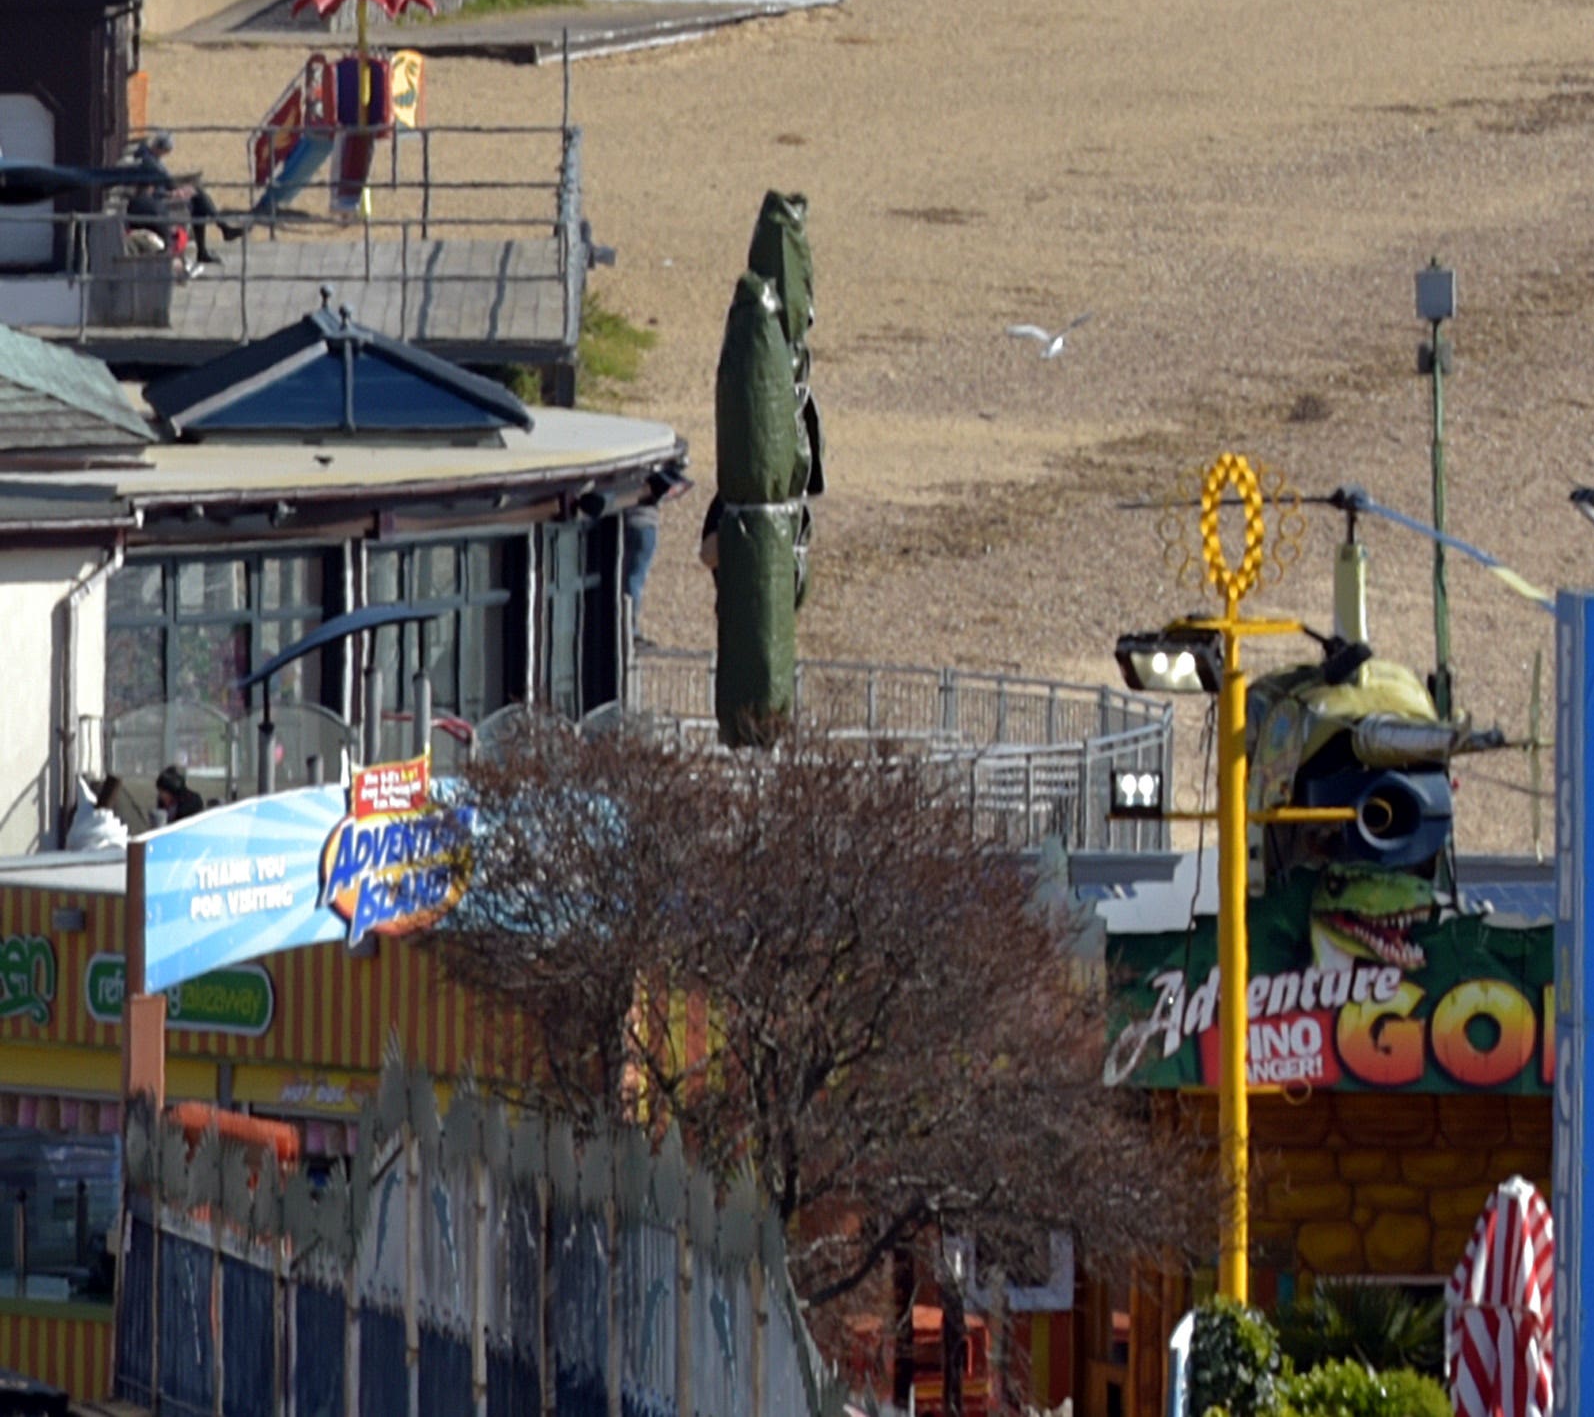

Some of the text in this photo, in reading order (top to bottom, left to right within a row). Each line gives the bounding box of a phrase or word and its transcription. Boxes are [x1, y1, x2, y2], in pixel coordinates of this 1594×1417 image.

[195, 855, 287, 890] THANK YOU
[190, 882, 295, 921] FOR VISITING
[348, 864, 451, 949] ISLAND
[1102, 965, 1402, 1088] Adenture
[1247, 1017, 1323, 1060] INO
